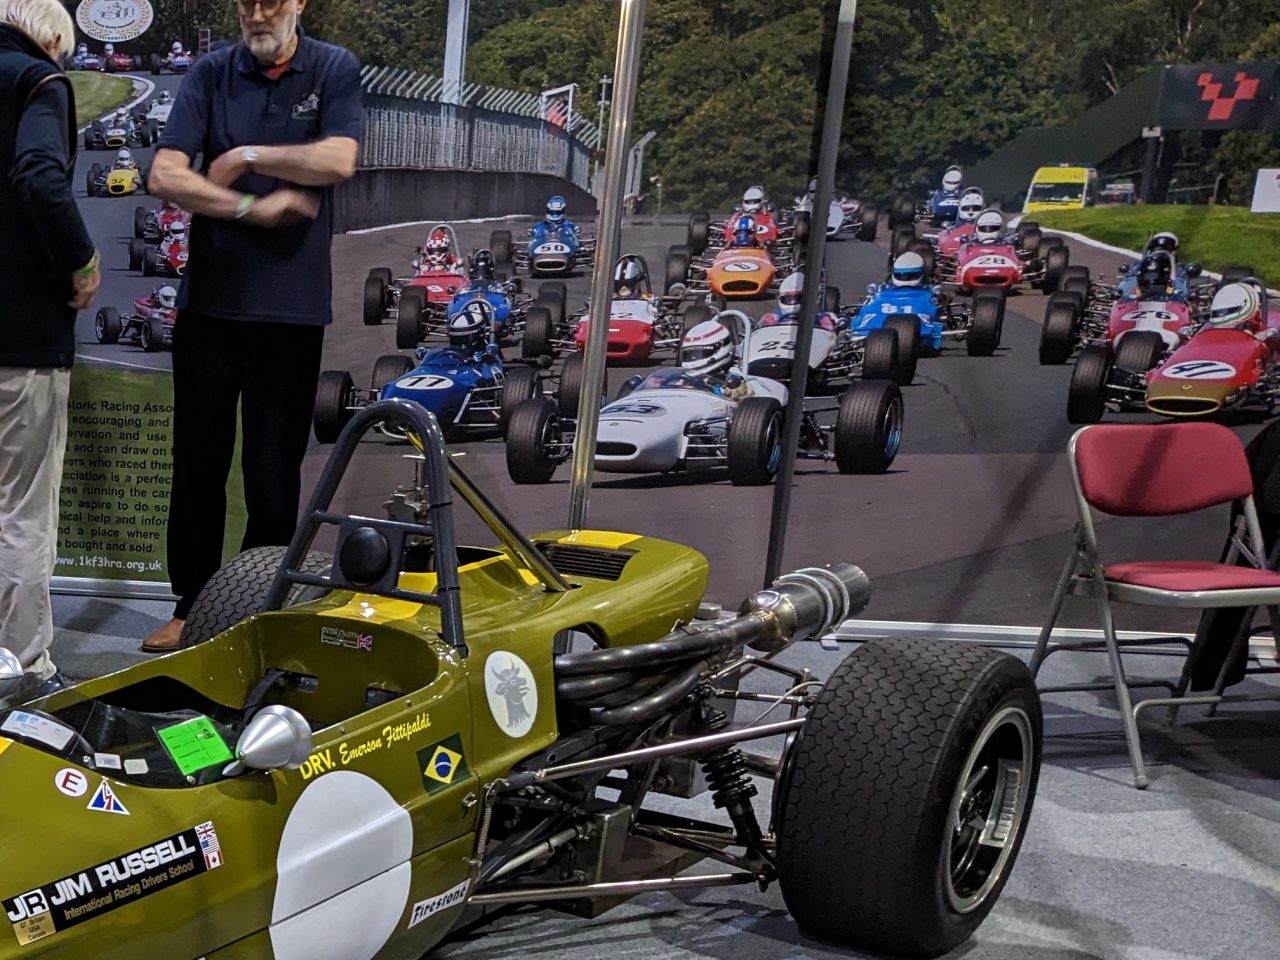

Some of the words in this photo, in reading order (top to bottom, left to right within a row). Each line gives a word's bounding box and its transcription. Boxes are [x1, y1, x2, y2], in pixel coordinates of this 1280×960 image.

[1130, 311, 1172, 319] 26
[1171, 362, 1231, 377] 41
[101, 401, 140, 414] Racing
[72, 416, 141, 428] encouraging
[148, 418, 169, 427] and
[119, 431, 140, 441] and
[74, 443, 94, 453] and
[97, 446, 117, 454] can
[121, 445, 148, 455] draw
[152, 448, 166, 456] on
[89, 459, 112, 468] who
[116, 460, 146, 469] raced
[111, 473, 120, 482] is
[82, 487, 125, 498] running
[130, 487, 147, 497] the
[78, 500, 112, 510] aspire
[118, 502, 128, 510] to
[134, 502, 149, 511] do
[87, 513, 111, 524] help
[115, 515, 136, 525] and
[91, 527, 120, 537] place
[127, 529, 160, 539] where
[65, 540, 103, 551] bought
[106, 541, 126, 551] and
[129, 544, 156, 553] sold.
[299, 750, 336, 780] DRV.
[339, 738, 382, 765] Emerson
[382, 713, 432, 748] Fittipaldi
[61, 771, 82, 794] E
[51, 873, 93, 906] JIM
[95, 835, 196, 888] RUSSELL
[64, 892, 113, 921] International
[114, 883, 141, 901] Racing
[141, 872, 168, 890] Drivers
[169, 858, 195, 878] School
[413, 887, 466, 924] Firestone
